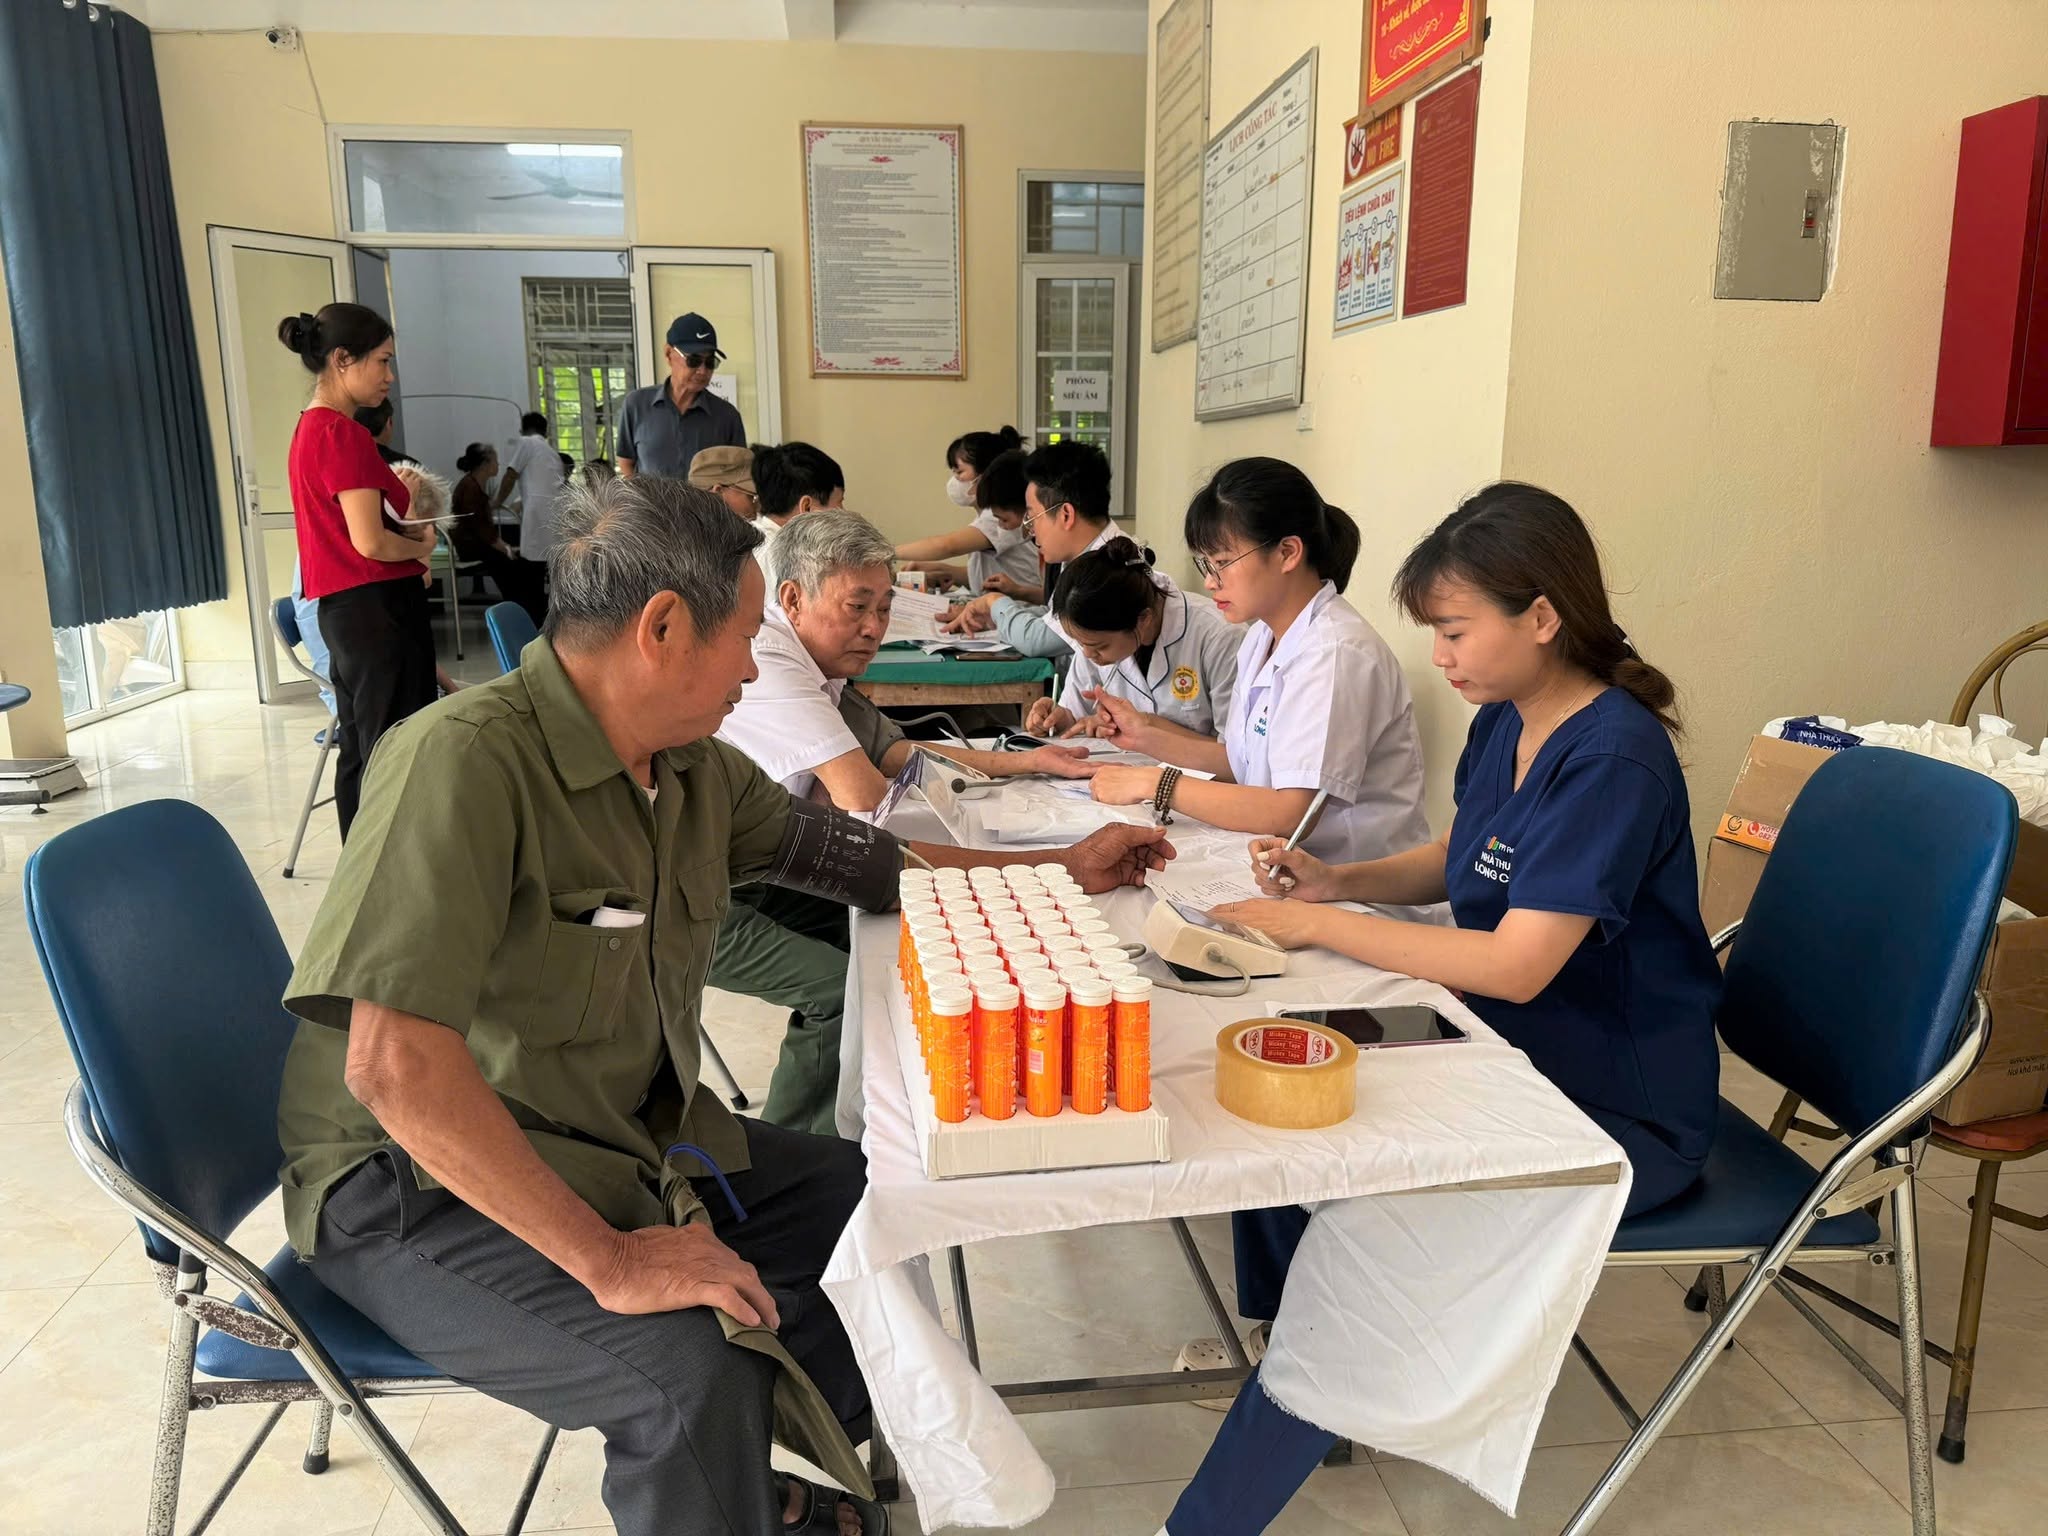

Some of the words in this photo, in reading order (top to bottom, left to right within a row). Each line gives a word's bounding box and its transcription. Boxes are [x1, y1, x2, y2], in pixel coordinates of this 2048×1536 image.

[1379, 134, 1395, 160] FIRE
[1800, 730, 1816, 740] NHÀ
[1480, 851, 1494, 866] NHÀ
[1474, 860, 1497, 881] LONG
